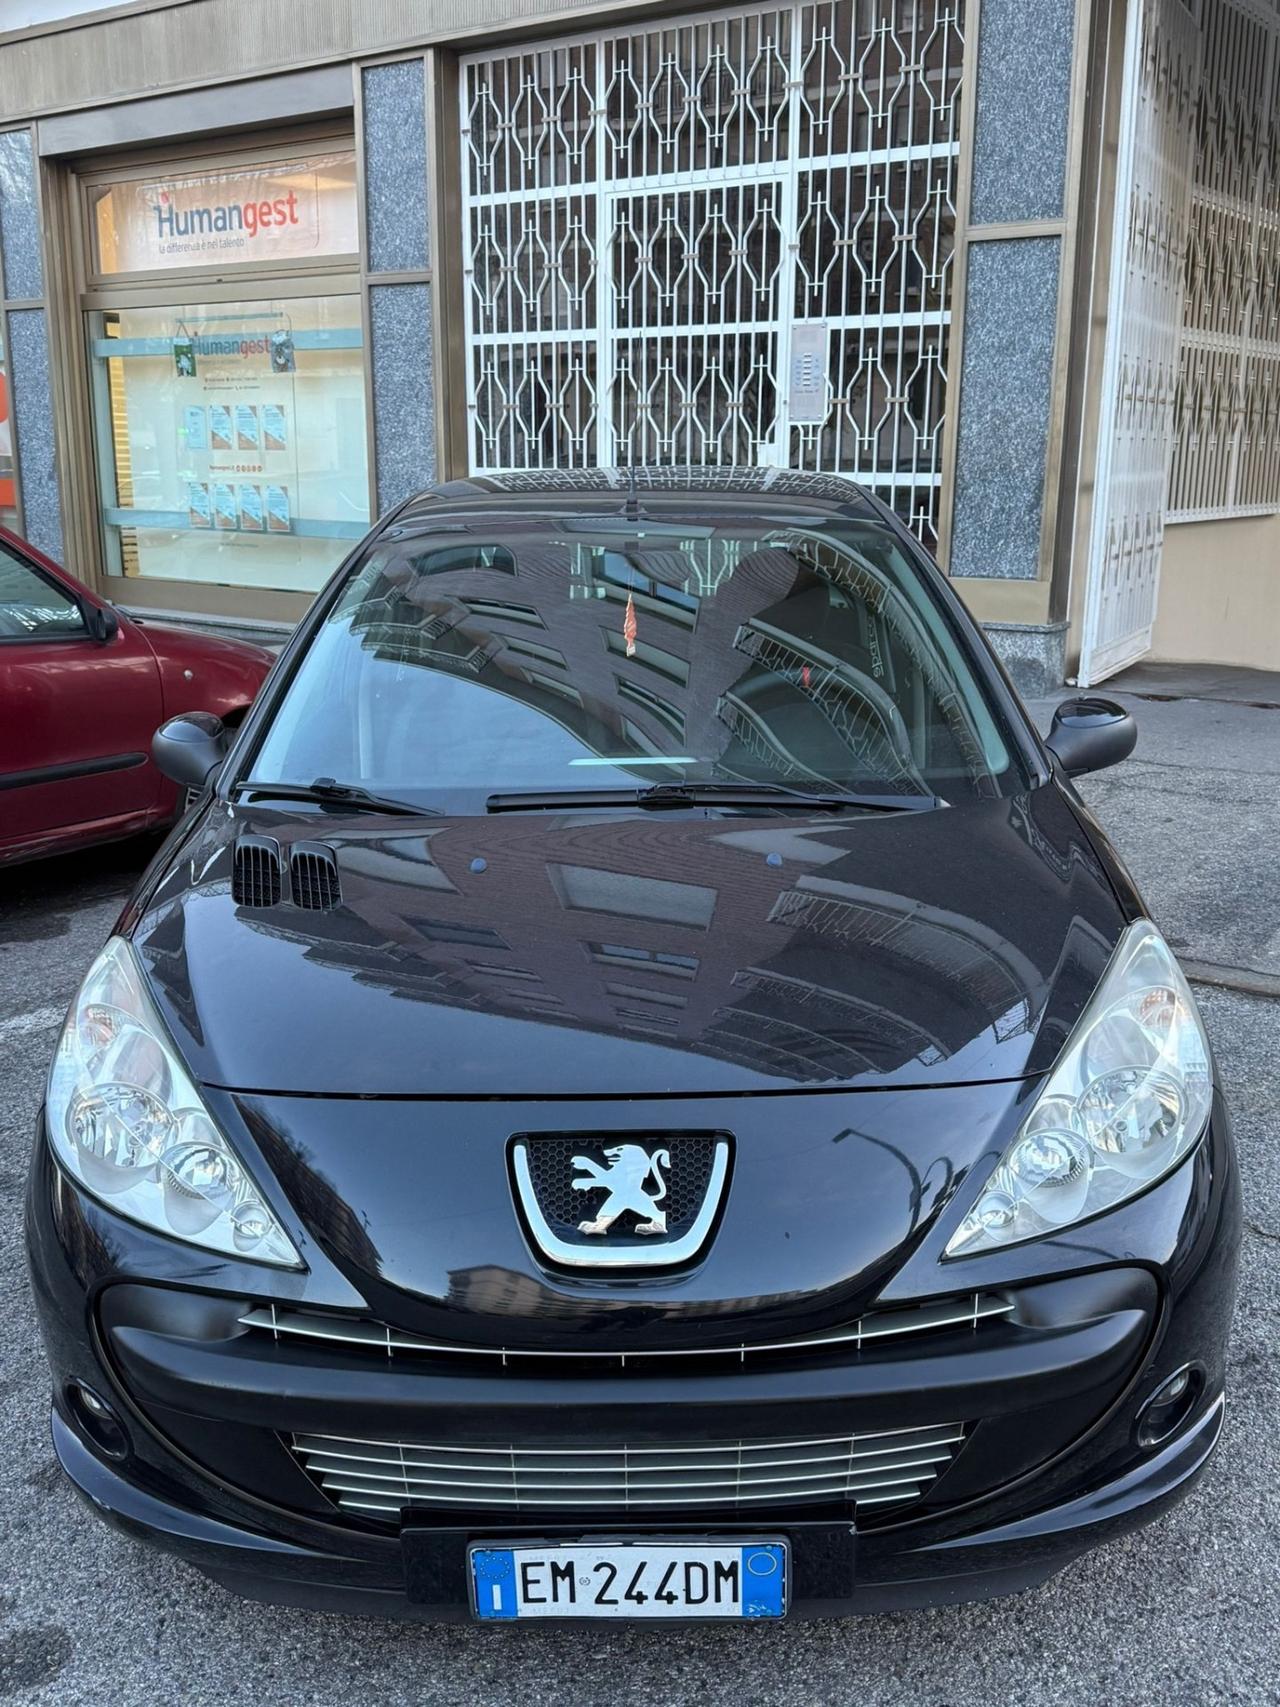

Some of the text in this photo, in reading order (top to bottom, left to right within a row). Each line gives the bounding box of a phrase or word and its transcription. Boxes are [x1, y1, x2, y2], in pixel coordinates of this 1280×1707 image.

[153, 190, 298, 237] Humangest
[219, 238, 244, 250] talento
[189, 332, 271, 358] Humangest
[520, 1560, 739, 1605] EM 244DM
